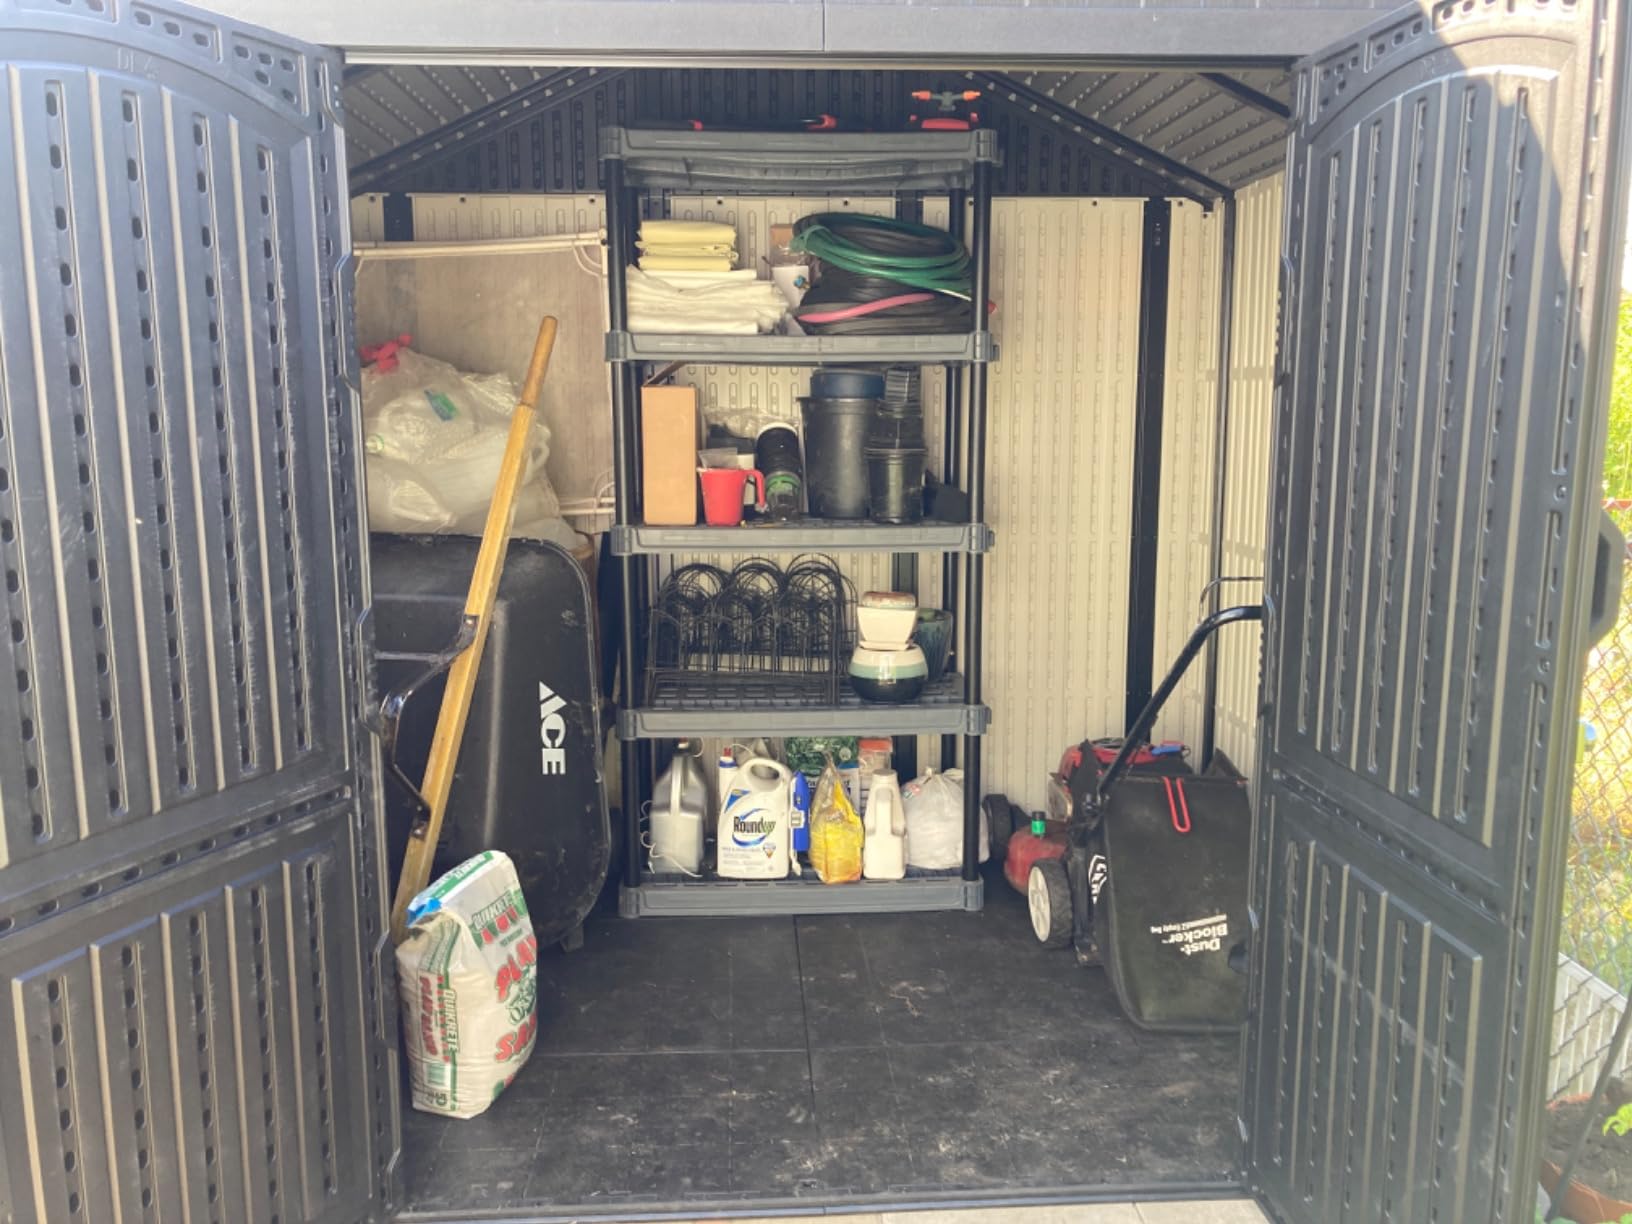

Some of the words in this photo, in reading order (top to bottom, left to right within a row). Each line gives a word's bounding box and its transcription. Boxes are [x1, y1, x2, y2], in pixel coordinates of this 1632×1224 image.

[538, 681, 567, 775] ACE
[733, 816, 777, 836] Roundup
[1168, 923, 1228, 943] Blocker
[444, 989, 459, 1053] QUIKRETE
